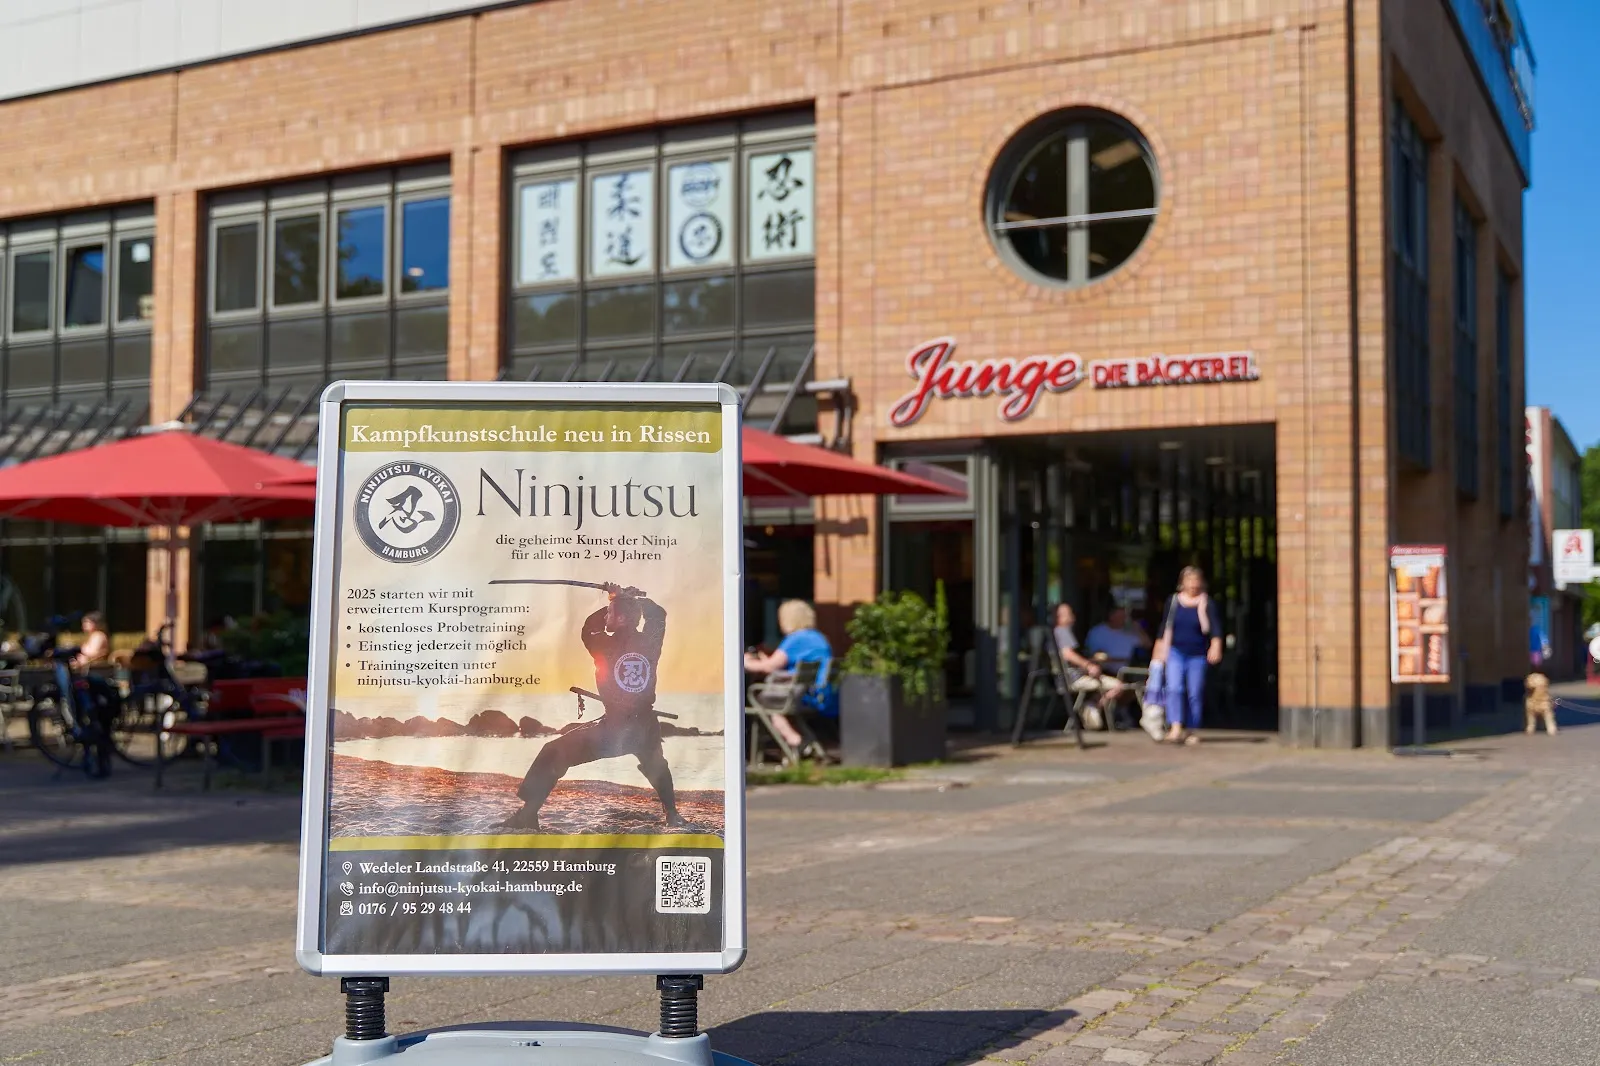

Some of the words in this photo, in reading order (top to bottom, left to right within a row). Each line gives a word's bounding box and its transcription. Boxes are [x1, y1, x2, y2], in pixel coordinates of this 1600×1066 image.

[889, 337, 1081, 426] Junge
[1092, 362, 1129, 388] DIE
[351, 424, 557, 448] Kampfkunstschule
[563, 429, 604, 444] neu
[611, 424, 632, 444] in
[639, 424, 711, 444] Rissen
[361, 464, 411, 504] NINJUTSU
[476, 467, 700, 531] Ninjutsu
[495, 534, 515, 546] die
[519, 534, 573, 548] geheime
[576, 534, 614, 546] Kunst
[617, 534, 638, 546] der
[642, 535, 678, 549] Ninja
[382, 545, 429, 559] HAMBURG
[511, 550, 529, 560] für
[533, 550, 555, 560] alle
[558, 550, 580, 560] von
[584, 549, 592, 560] 2
[603, 549, 618, 560] 99
[619, 549, 662, 564] Jahren
[347, 588, 376, 600] 2025
[380, 589, 424, 600] starten
[428, 588, 449, 599] wir
[451, 587, 474, 599] mit
[347, 603, 424, 614] erweitertem
[427, 602, 530, 616] Kursprogramm:
[358, 622, 433, 633] kostenloses
[436, 622, 526, 636] Probetraining
[358, 640, 413, 654] Einstieg
[416, 640, 472, 653] jederzeit
[475, 639, 528, 653] möglich
[357, 659, 459, 674] Trainingszeiten
[462, 660, 497, 670] unter
[357, 674, 541, 689] ninjutsu-kyokai-hamburg.de
[359, 860, 413, 875] Wedeler
[415, 860, 489, 874] Landstraße
[492, 860, 510, 875] 41,
[513, 860, 549, 873] 22559
[552, 860, 617, 875] Hamburg
[359, 880, 583, 898] info@ninjutsu-kyokai-hamburg.de
[358, 902, 388, 916] 0176
[390, 902, 399, 916] /
[402, 902, 418, 915] 95
[420, 902, 436, 915] 29
[438, 901, 455, 914] 48
[456, 901, 472, 914] 44
